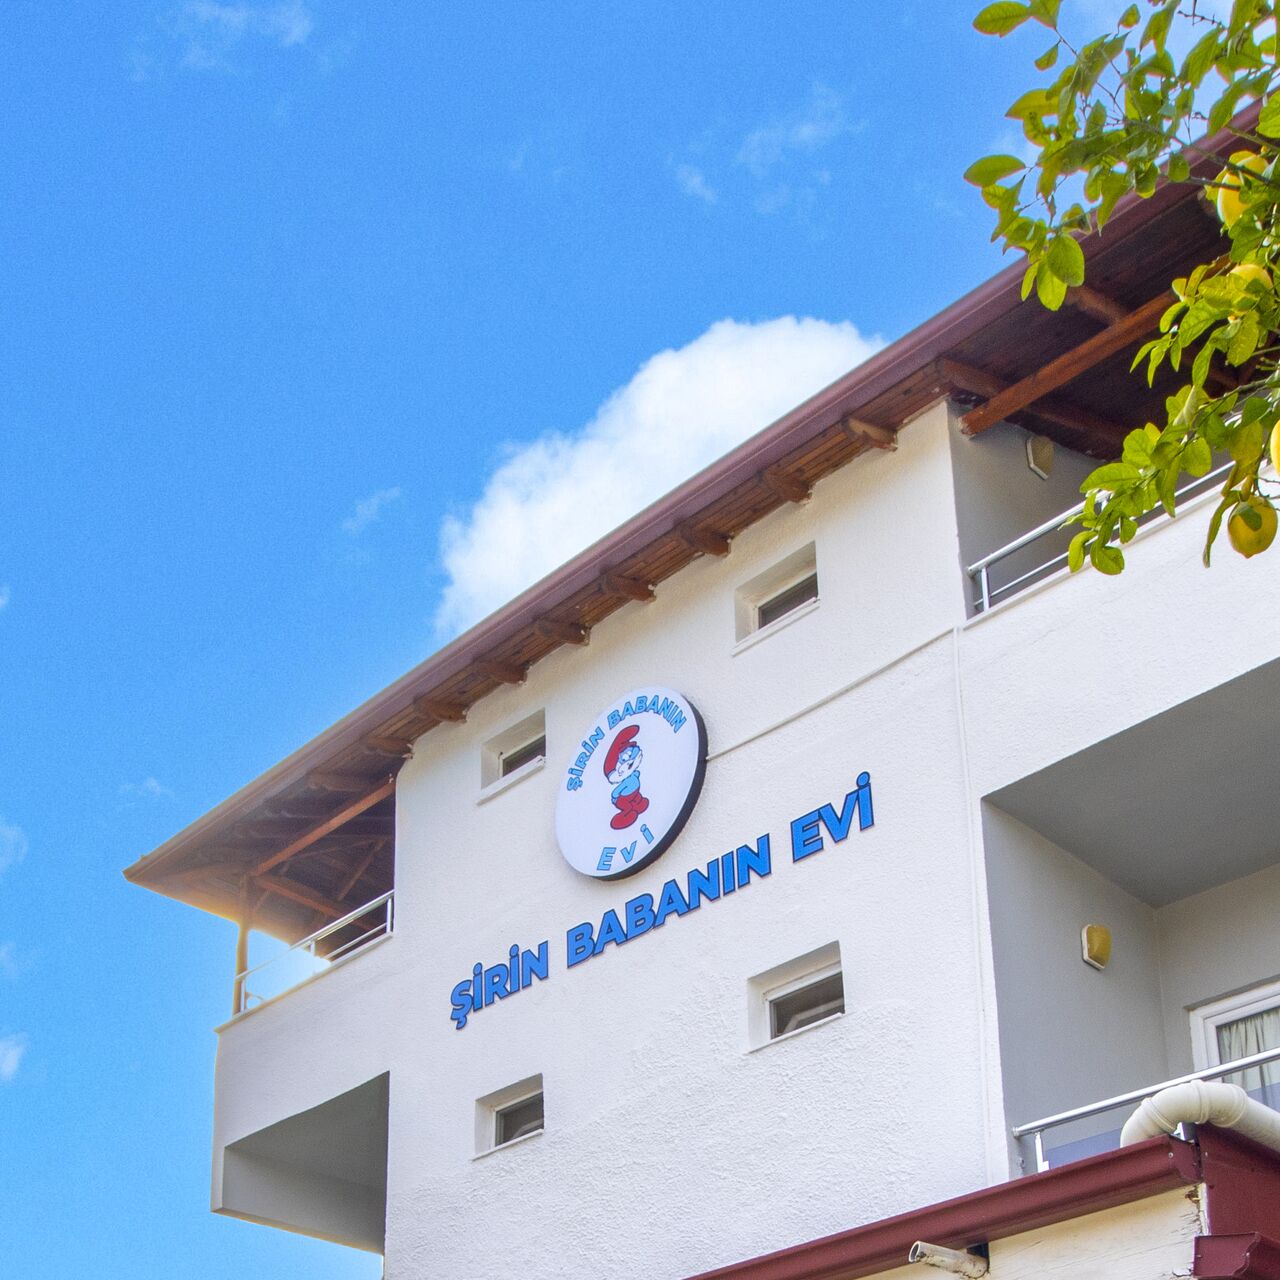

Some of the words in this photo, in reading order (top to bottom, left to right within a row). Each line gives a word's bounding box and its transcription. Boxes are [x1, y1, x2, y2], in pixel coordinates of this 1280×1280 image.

[566, 726, 605, 792] ŞİRİN
[607, 694, 688, 734] BABANIN
[450, 940, 549, 1030] ŞİRİN
[566, 833, 772, 969] BABANIN
[790, 771, 875, 863] EVİ
